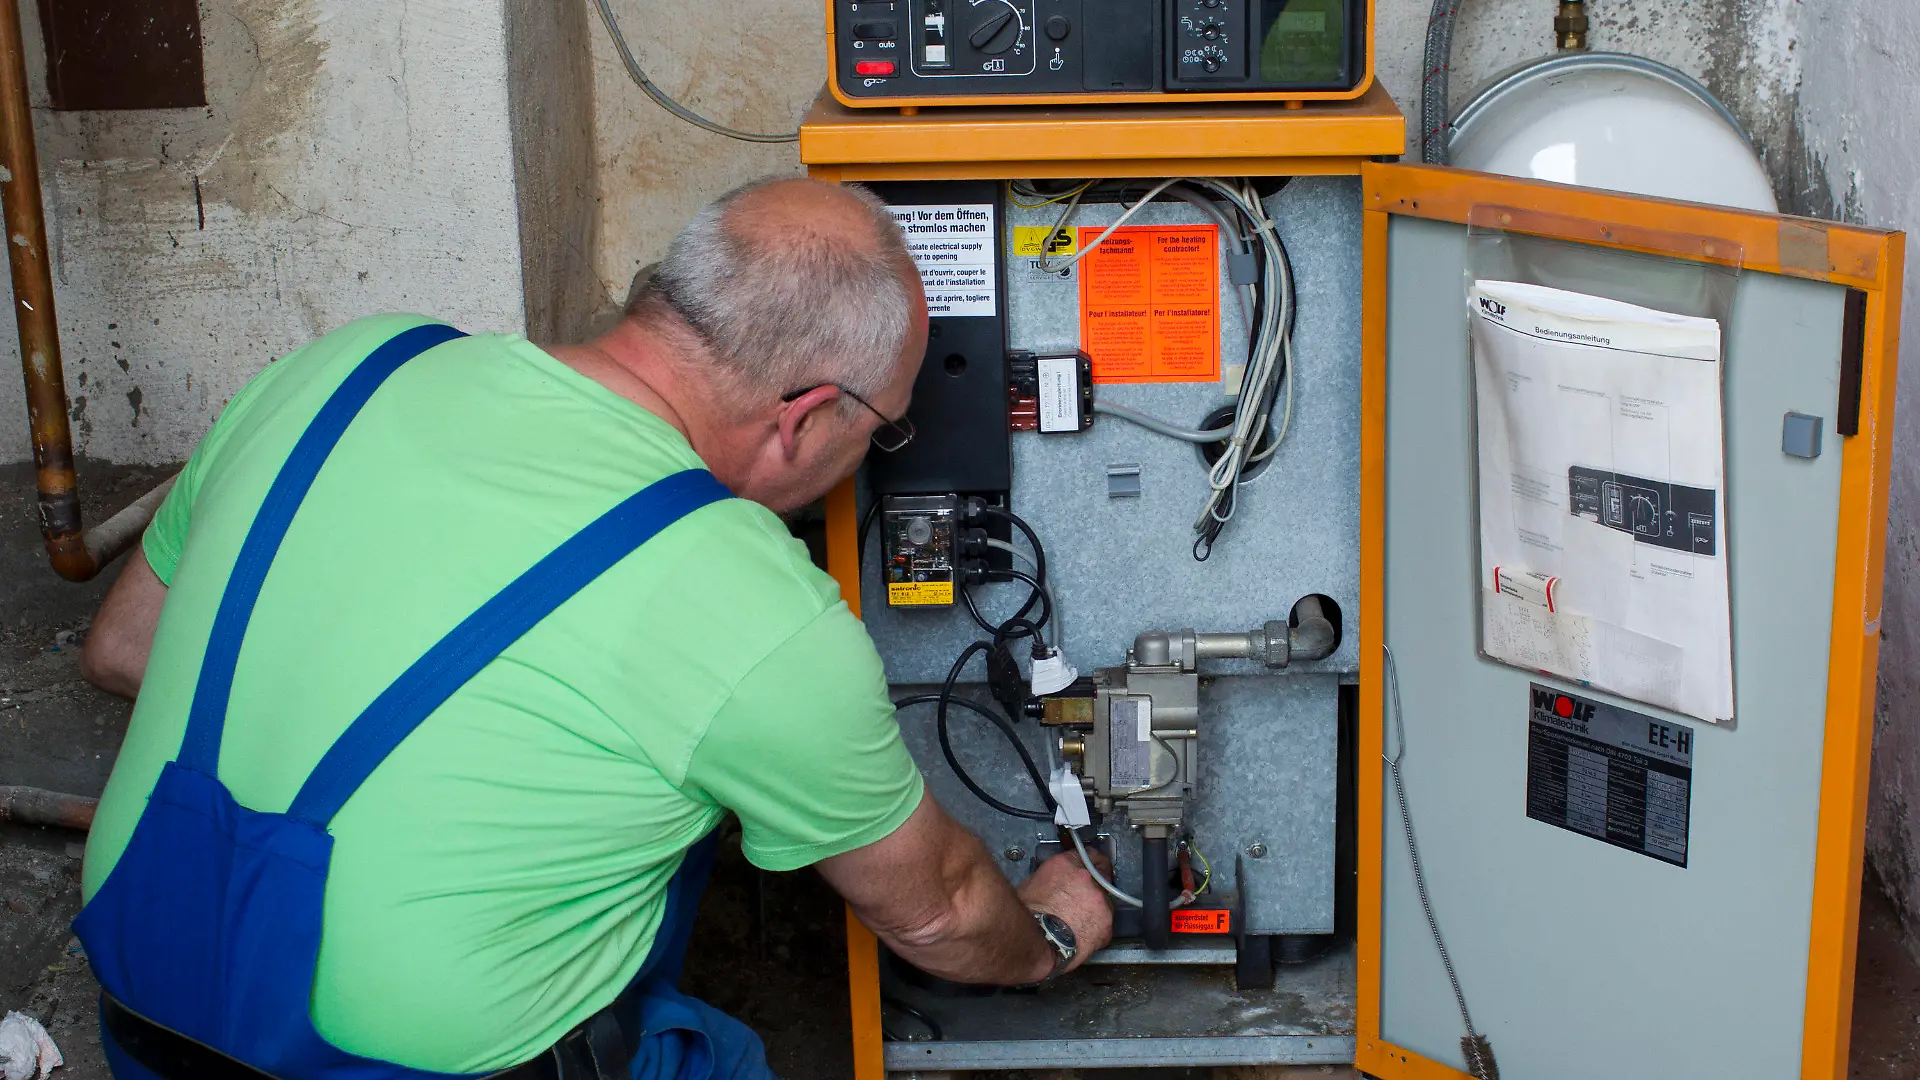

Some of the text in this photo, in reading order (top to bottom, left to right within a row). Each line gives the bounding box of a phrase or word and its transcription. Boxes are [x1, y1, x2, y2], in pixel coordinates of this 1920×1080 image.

[918, 211, 932, 220] Vor
[935, 210, 954, 220] dem
[956, 208, 989, 221] Öffnen,
[908, 223, 947, 233] stromlos
[950, 223, 986, 232] machen
[1181, 236, 1206, 244] heating
[1163, 245, 1200, 253] contractor!
[932, 253, 958, 261] opening
[929, 269, 956, 277] d'ouvrir,
[946, 278, 986, 286] l'installation
[943, 295, 965, 303] aprire,
[928, 304, 951, 312] orrente
[1479, 297, 1506, 315] WOLF
[1535, 326, 1610, 345] Bedienungsanleitung
[1532, 688, 1596, 722] WOLF
[1533, 710, 1589, 734] Klimatechnik
[1648, 722, 1690, 754] EE-H
[1217, 914, 1225, 929] F
[1184, 922, 1214, 931] Flüssiggas
